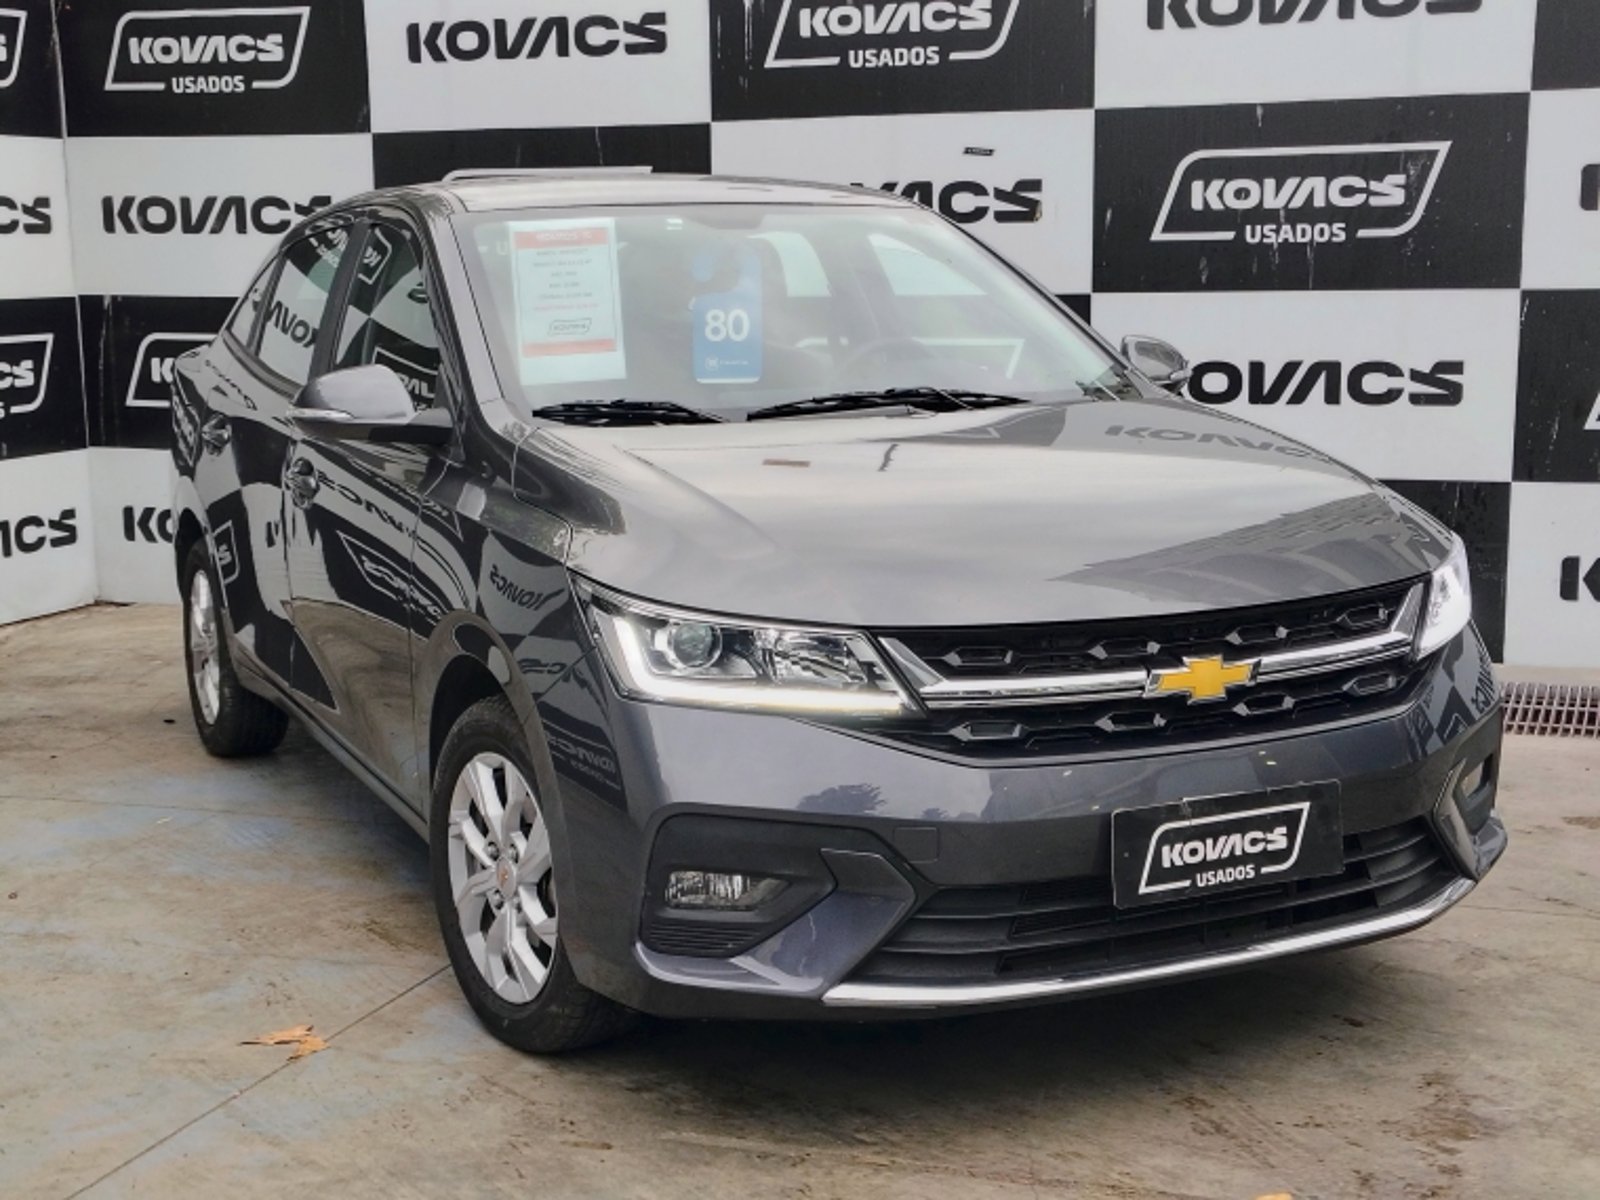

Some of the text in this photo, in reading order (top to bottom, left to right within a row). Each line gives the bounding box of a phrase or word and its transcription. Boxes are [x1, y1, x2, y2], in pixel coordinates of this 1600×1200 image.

[799, 0, 993, 38] KOVACS
[128, 33, 285, 65] KOVACS
[406, 11, 668, 63] KOVACS
[848, 46, 941, 69] USADOS
[171, 75, 245, 94] USADOS
[1190, 174, 1406, 211] KOVACS
[1245, 222, 1347, 244] USADOS
[704, 308, 750, 342] 80
[1161, 826, 1288, 869] KOVACS
[1195, 864, 1256, 887] USADOS
